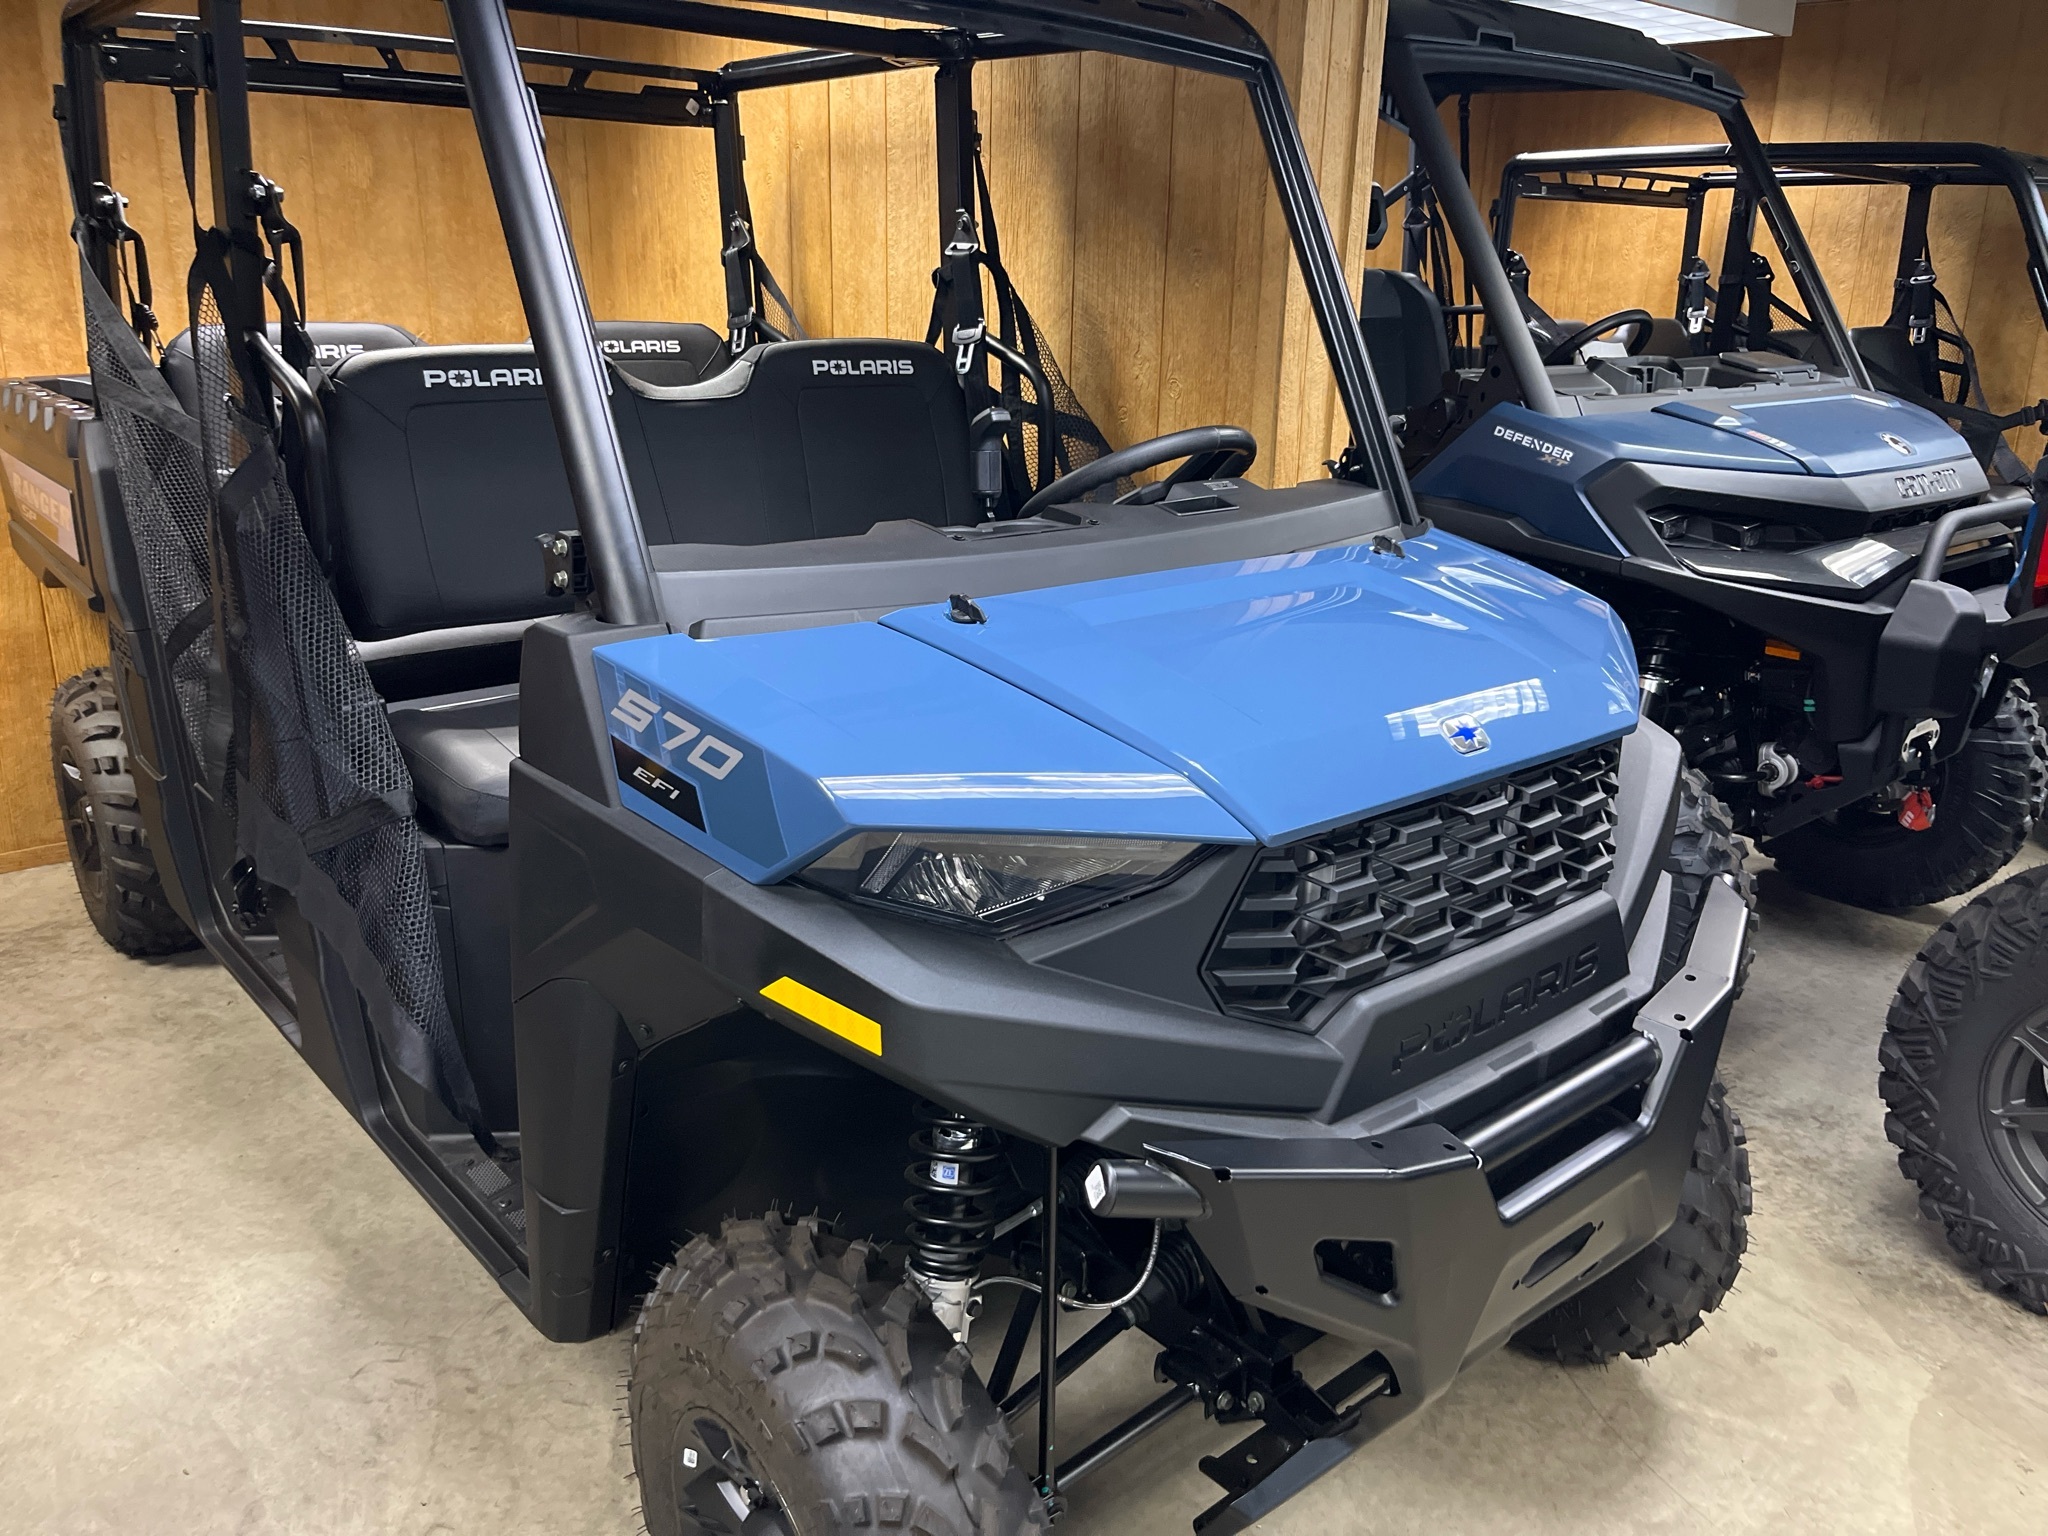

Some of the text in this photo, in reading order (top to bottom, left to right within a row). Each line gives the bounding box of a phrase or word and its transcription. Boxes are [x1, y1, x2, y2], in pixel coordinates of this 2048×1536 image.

[598, 340, 681, 353] OLARIS
[422, 368, 543, 388] POLARI
[811, 359, 914, 375] POLARIS
[1493, 425, 1574, 461] DEFENDER
[12, 472, 71, 532] RANGER
[610, 688, 744, 781] 570
[632, 766, 680, 800] EFI
[1391, 942, 1599, 1075] POLARIS
